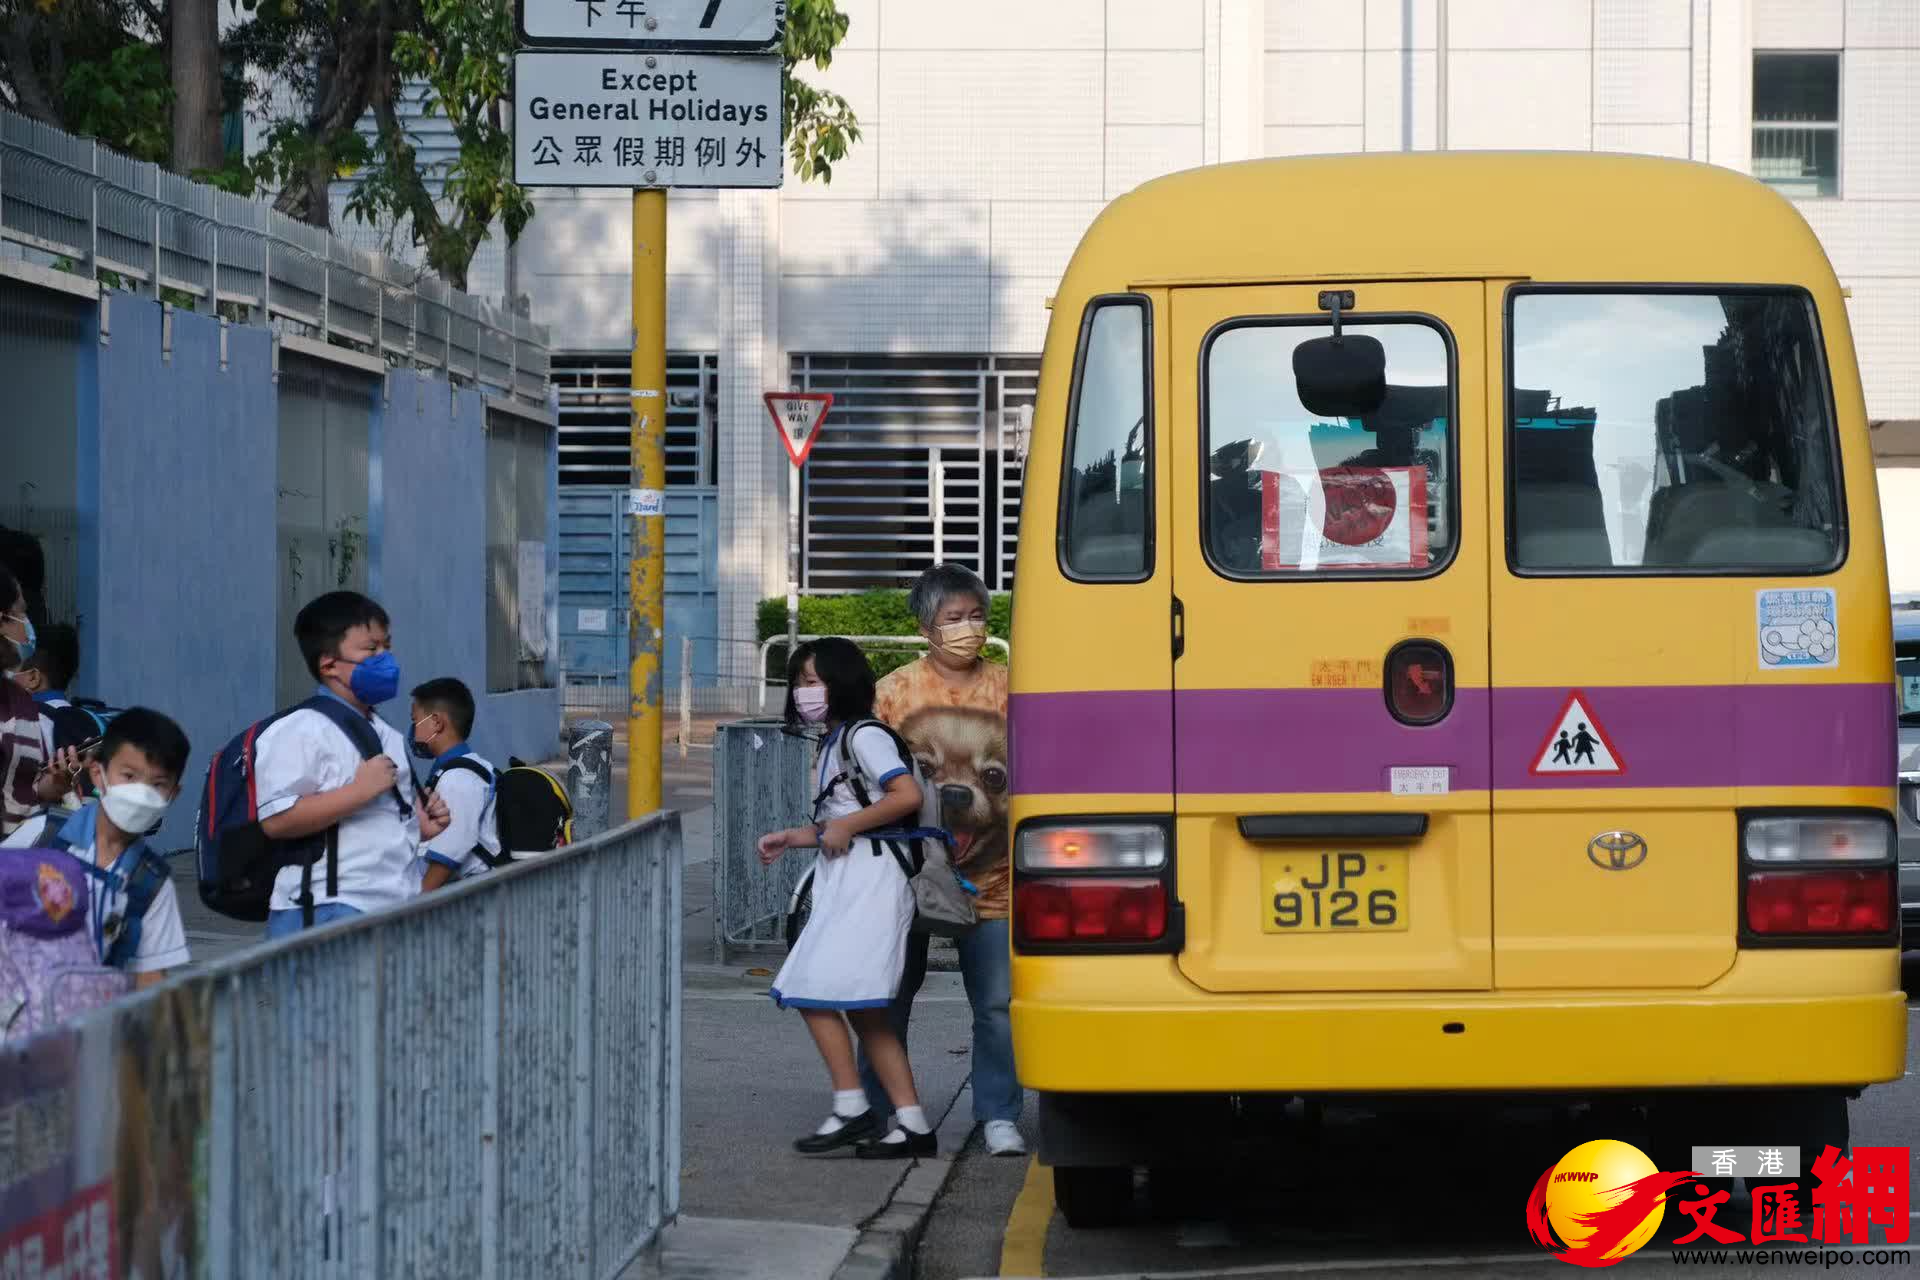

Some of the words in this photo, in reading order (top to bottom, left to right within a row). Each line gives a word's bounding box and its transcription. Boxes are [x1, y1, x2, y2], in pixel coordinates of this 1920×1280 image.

[575, 0, 646, 28] 下午
[602, 68, 697, 95] Except
[529, 96, 637, 120] General
[650, 98, 768, 126] Holidays
[532, 136, 767, 168] 公眾假期例外
[786, 401, 809, 411] GIVE
[788, 413, 809, 422] WAY
[1300, 852, 1366, 890] JP
[1273, 889, 1397, 927] 9126
